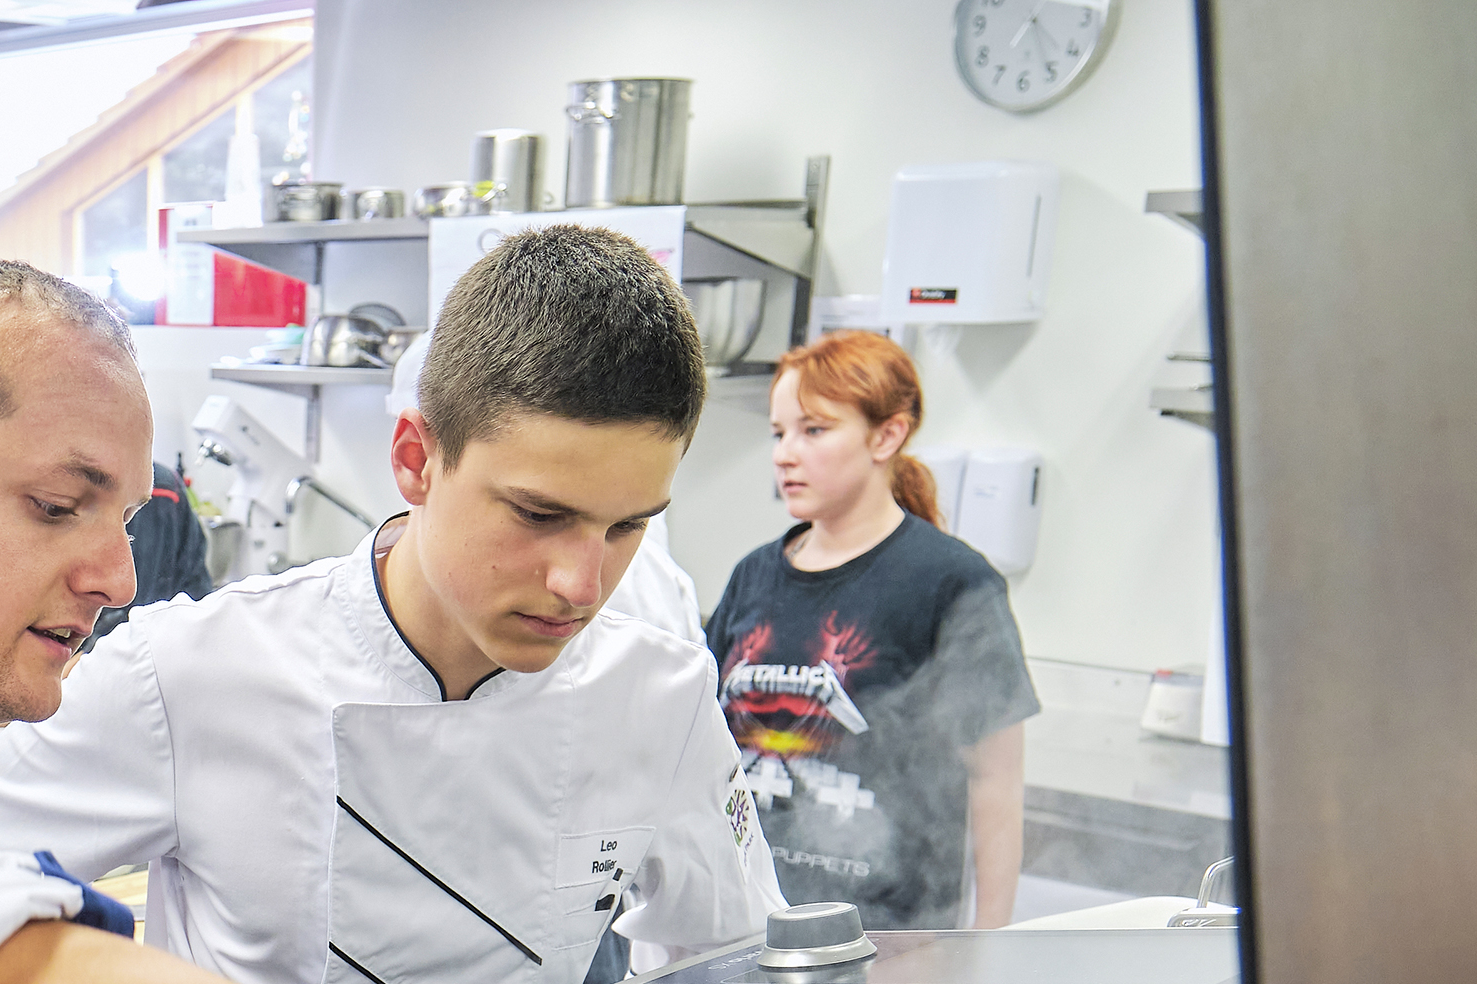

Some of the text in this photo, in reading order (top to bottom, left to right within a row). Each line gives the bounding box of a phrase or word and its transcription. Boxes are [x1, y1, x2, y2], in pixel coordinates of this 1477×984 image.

[973, 14, 987, 37] 9
[975, 45, 990, 69] 8
[992, 64, 1007, 86] 7
[1016, 70, 1031, 93] 6
[1044, 60, 1058, 84] 5
[720, 657, 870, 735] METALLICA
[600, 839, 618, 852] Leo
[773, 846, 871, 877] PUPPETS
